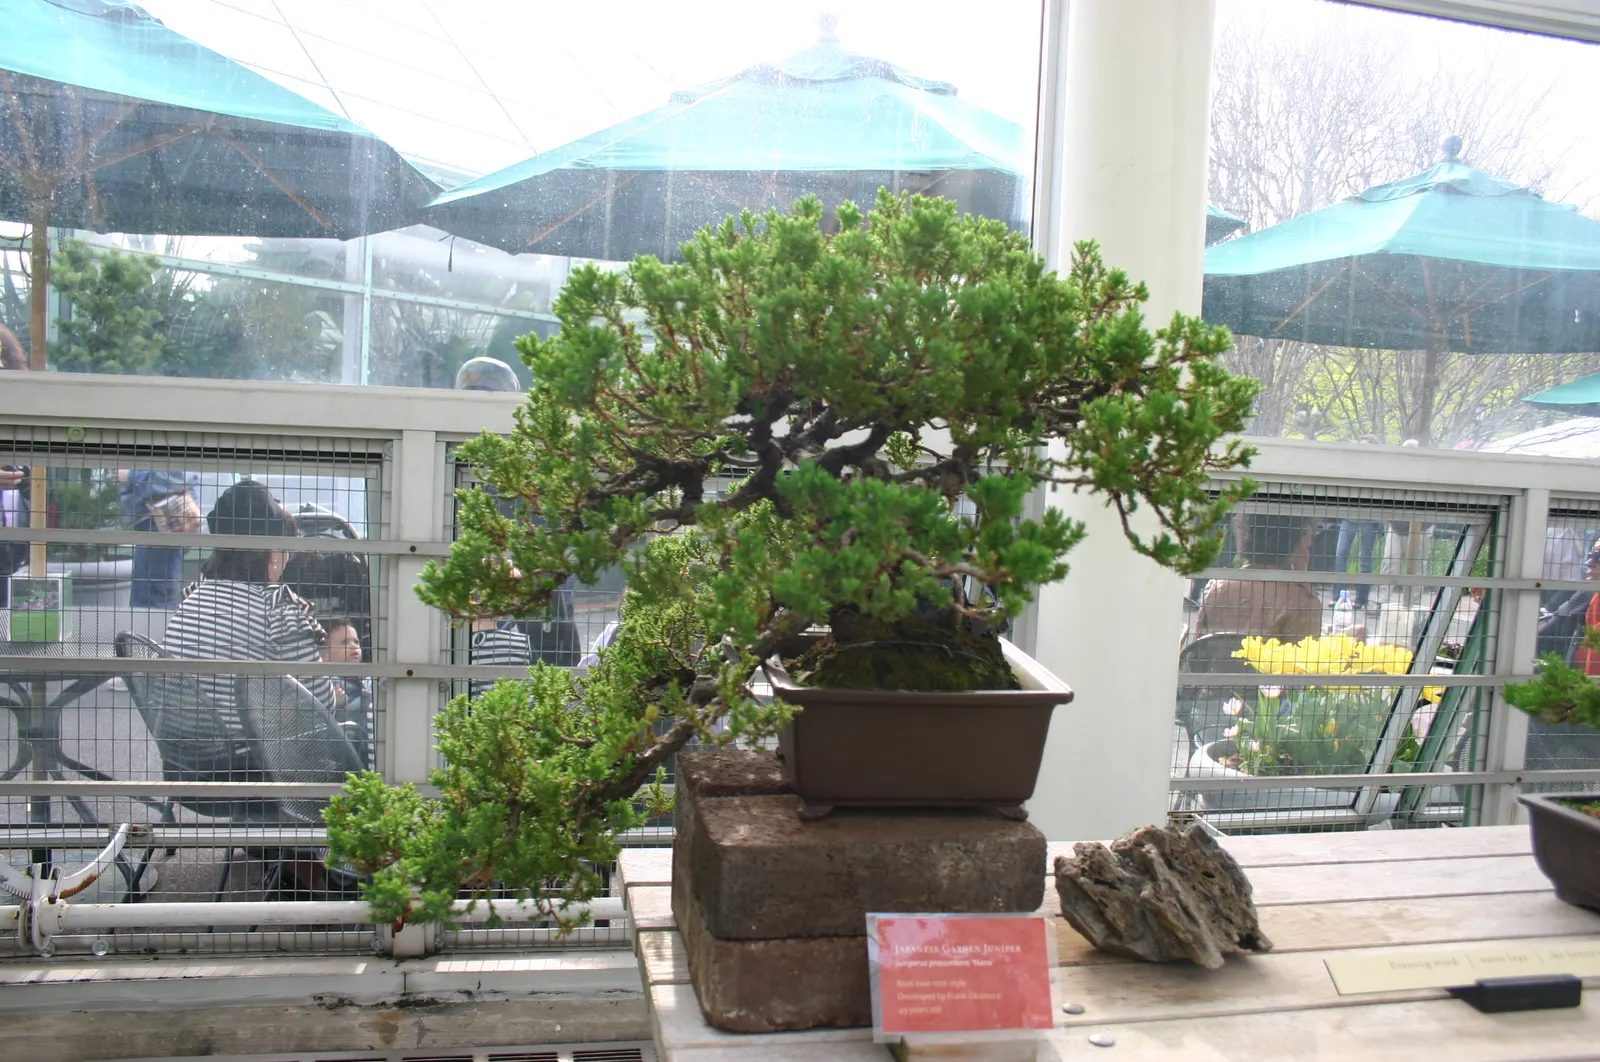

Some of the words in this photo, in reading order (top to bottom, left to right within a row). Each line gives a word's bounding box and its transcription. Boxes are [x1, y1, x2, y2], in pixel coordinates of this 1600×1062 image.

[942, 944, 981, 953] GARDEN
[983, 943, 1021, 955] JUNIPER
[1388, 959, 1432, 971] Evening
